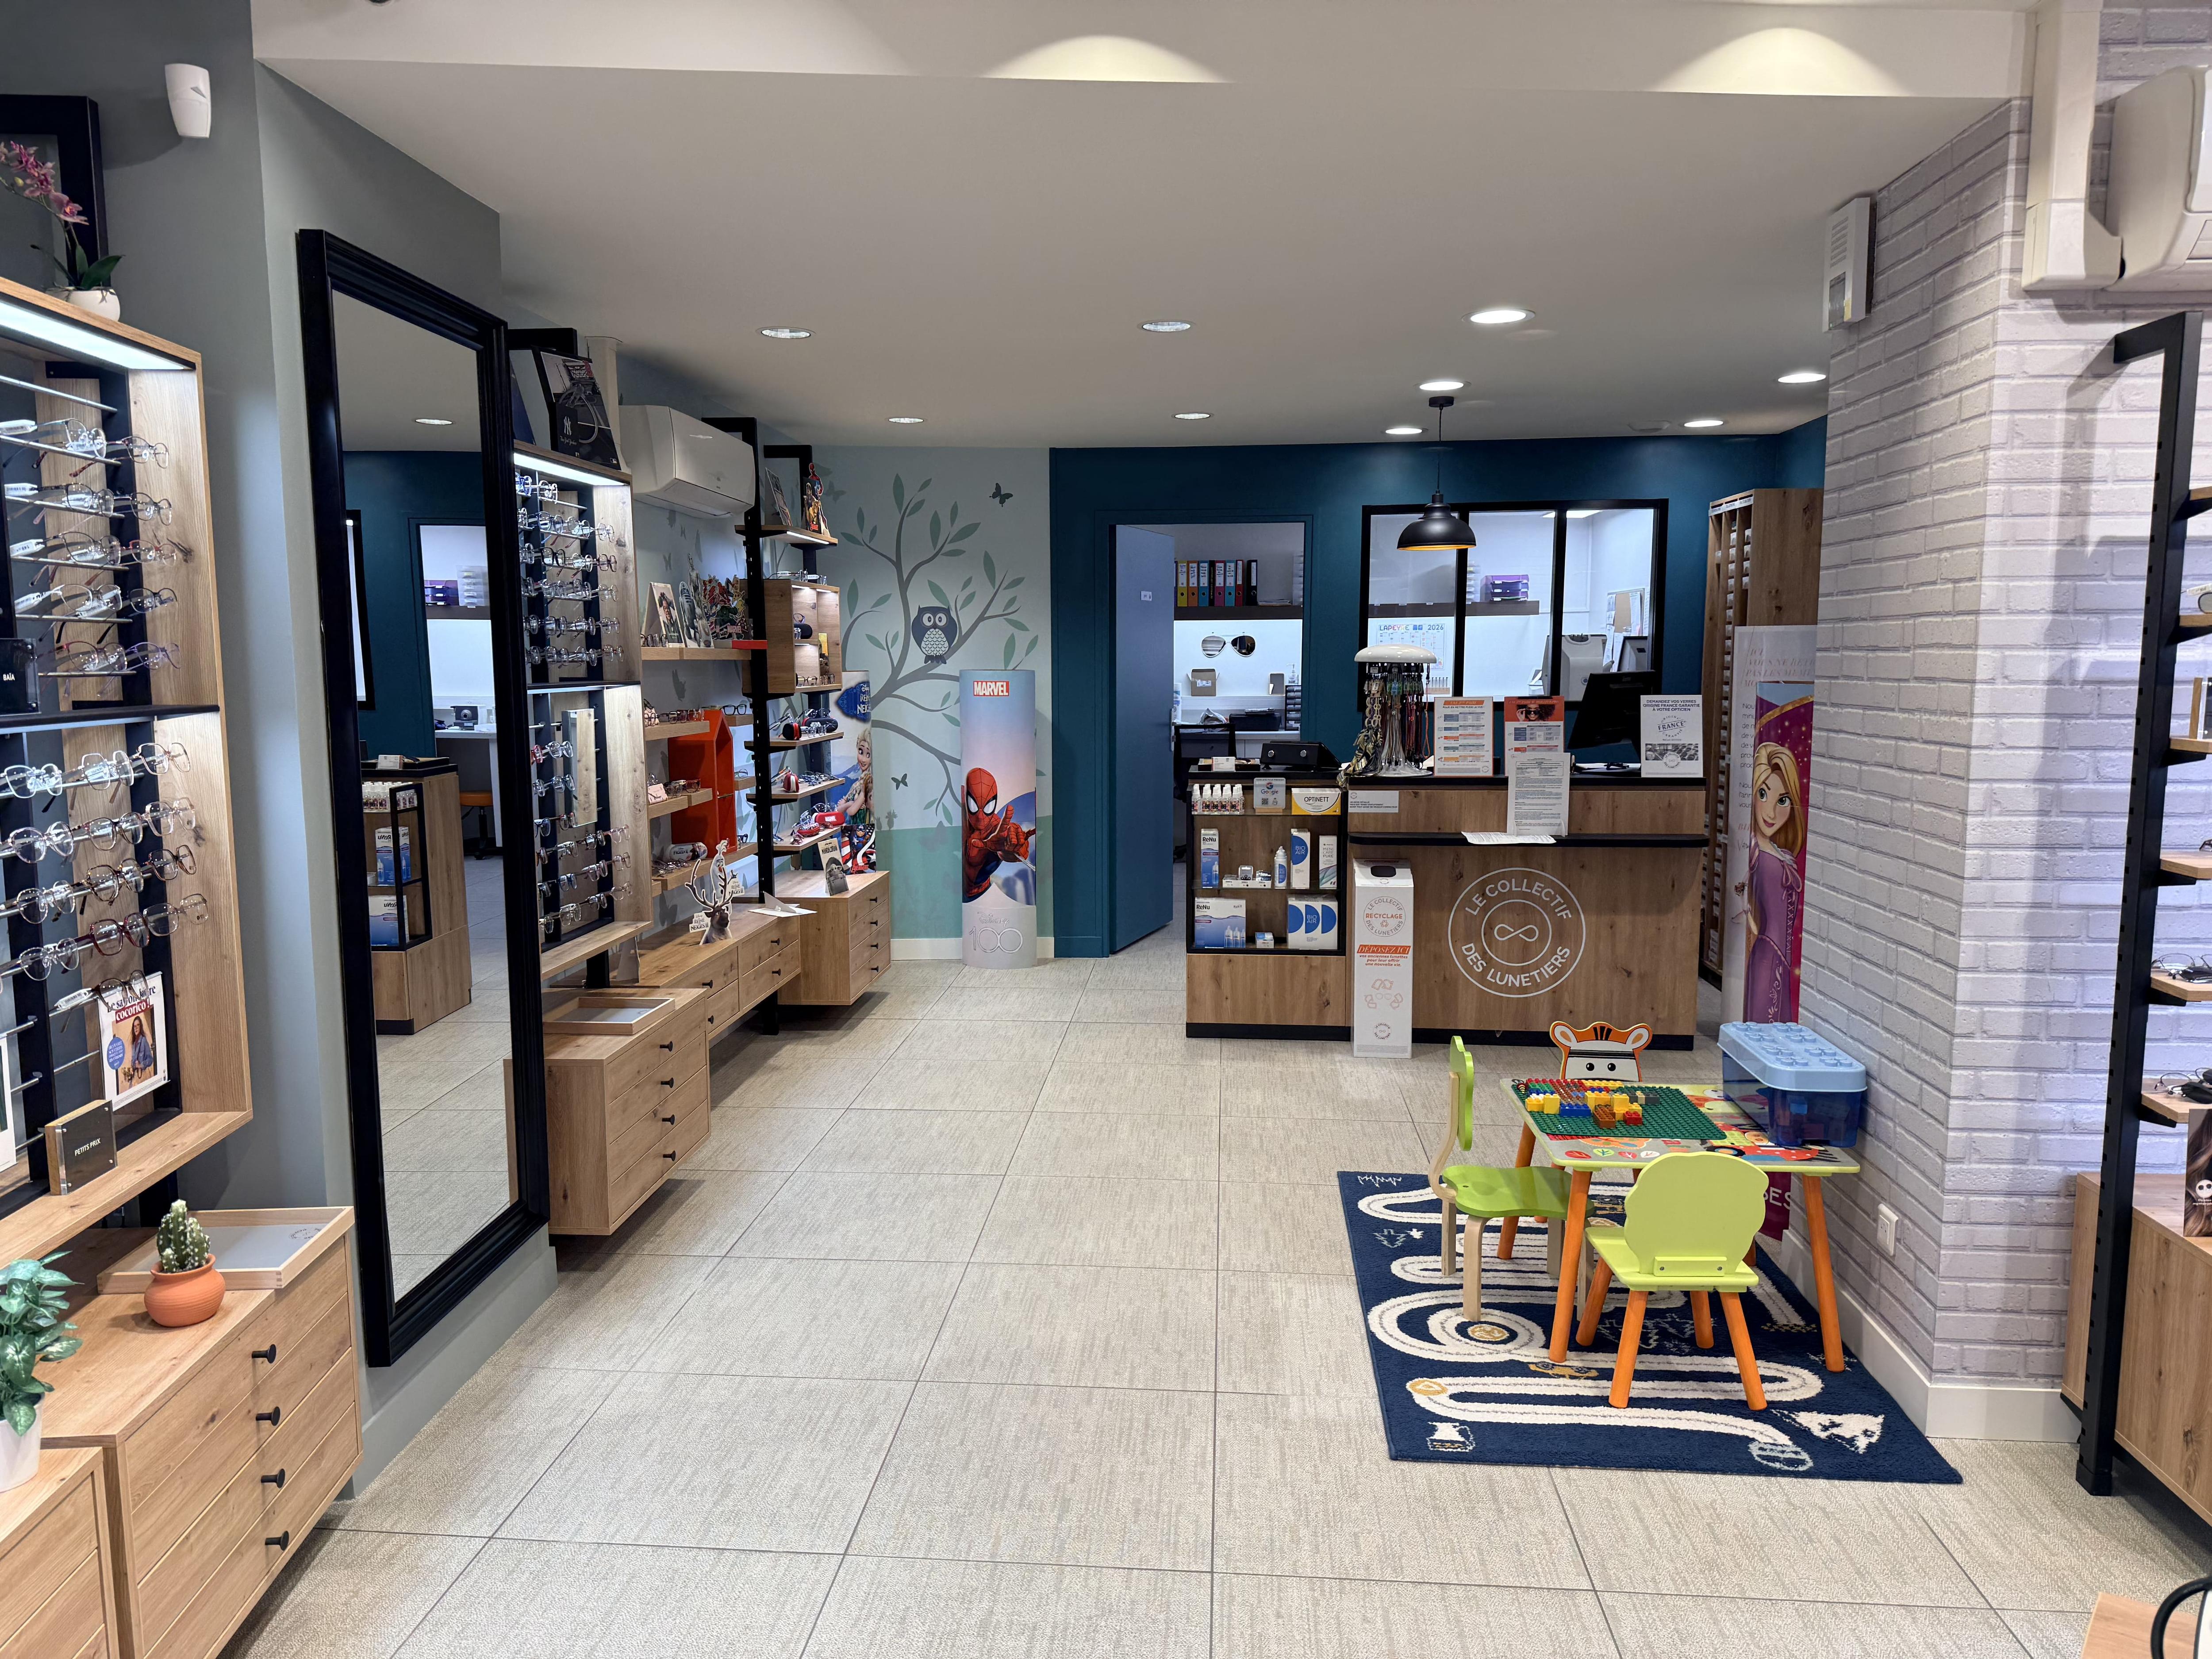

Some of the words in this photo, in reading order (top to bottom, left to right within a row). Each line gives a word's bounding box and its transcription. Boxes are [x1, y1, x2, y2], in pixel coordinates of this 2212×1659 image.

[974, 682, 1008, 695] MARVEL
[1658, 721, 1685, 730] FRANCE
[1375, 898, 1403, 911] COLLECTIF
[1465, 893, 1486, 915] LE
[1486, 879, 1571, 919] COLLECTIF
[1366, 920, 1375, 930] DES
[1375, 920, 1403, 935] LUNETIERS
[969, 926, 1023, 953] 100
[1462, 943, 1486, 972] DES
[1486, 946, 1570, 987] LUNETIERS
[116, 1002, 146, 1021] cocorico
[75, 1144, 89, 1156] PETITS
[90, 1138, 100, 1148] PRIX
